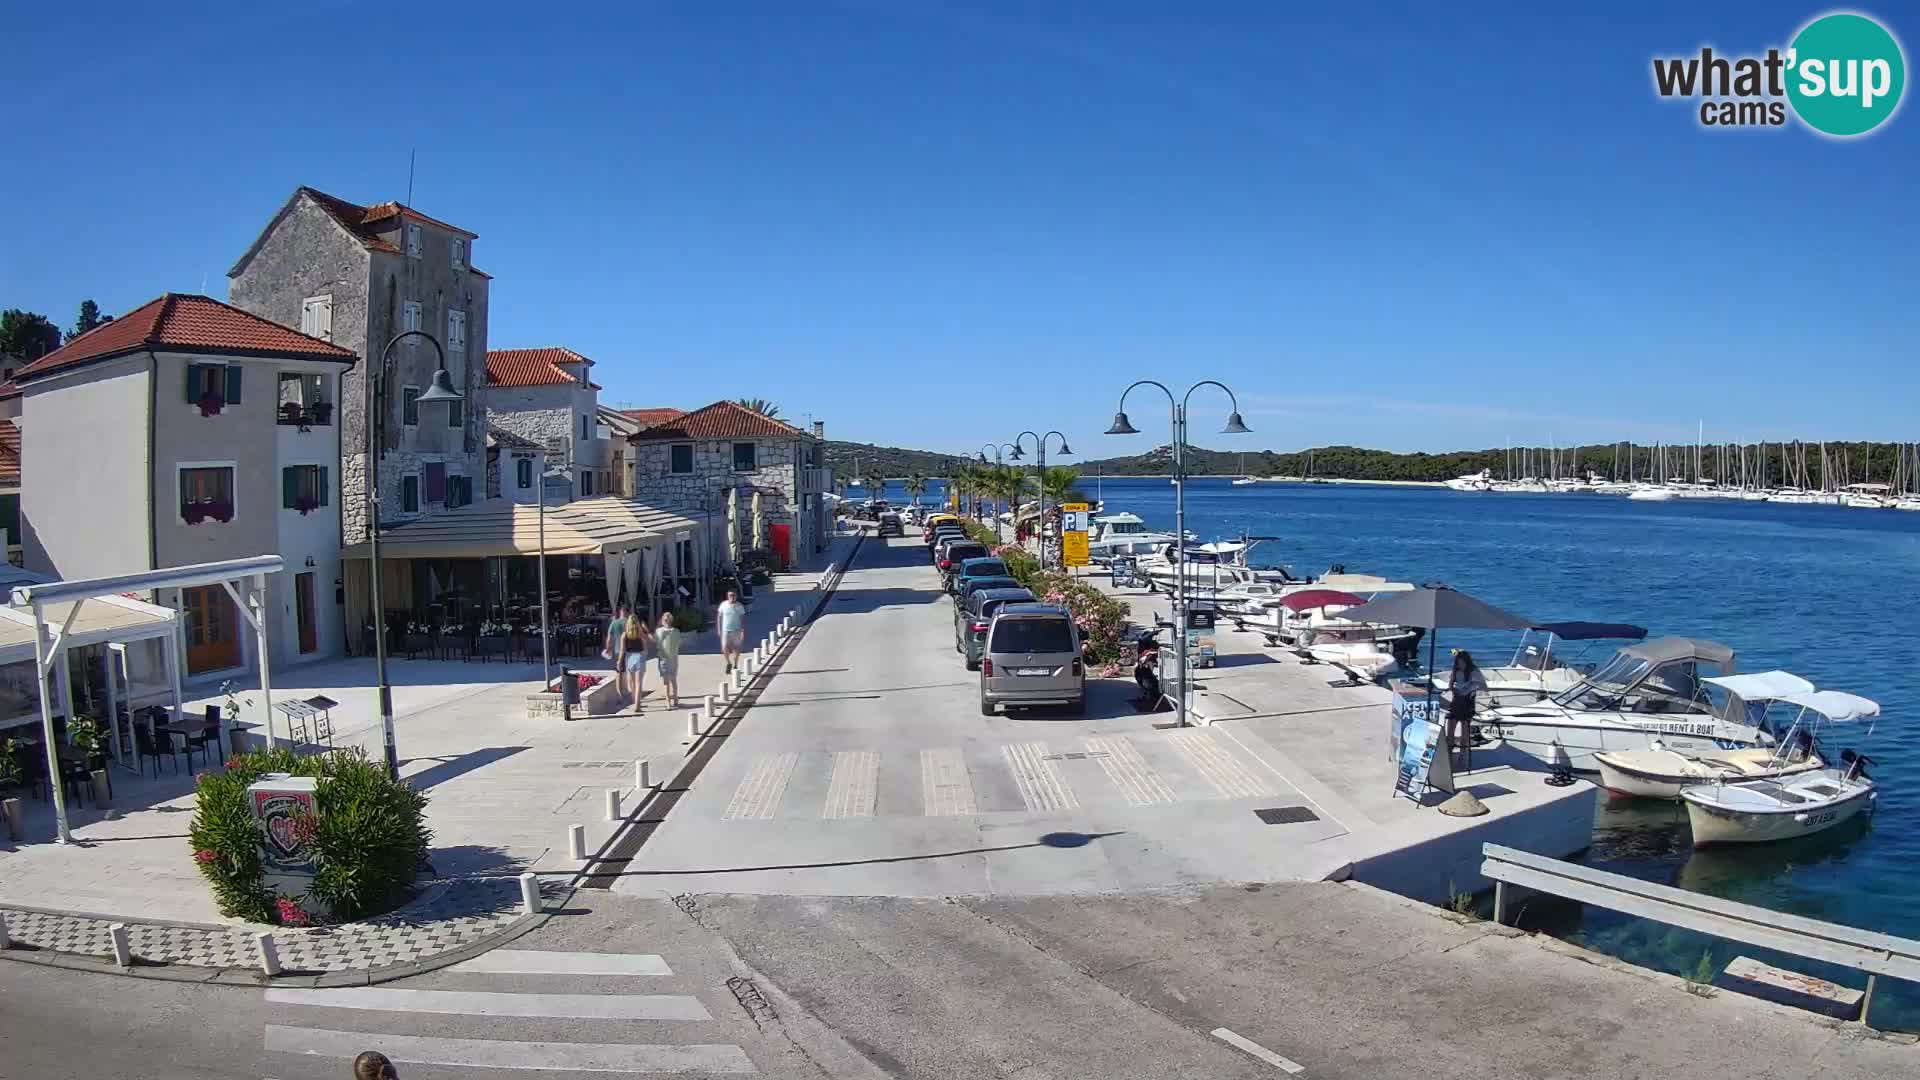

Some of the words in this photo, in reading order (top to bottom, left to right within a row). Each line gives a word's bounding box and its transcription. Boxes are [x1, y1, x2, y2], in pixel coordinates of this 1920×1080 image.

[1065, 513, 1075, 530] P
[1668, 723, 1689, 733] RENT
[1696, 724, 1715, 736] BOAT
